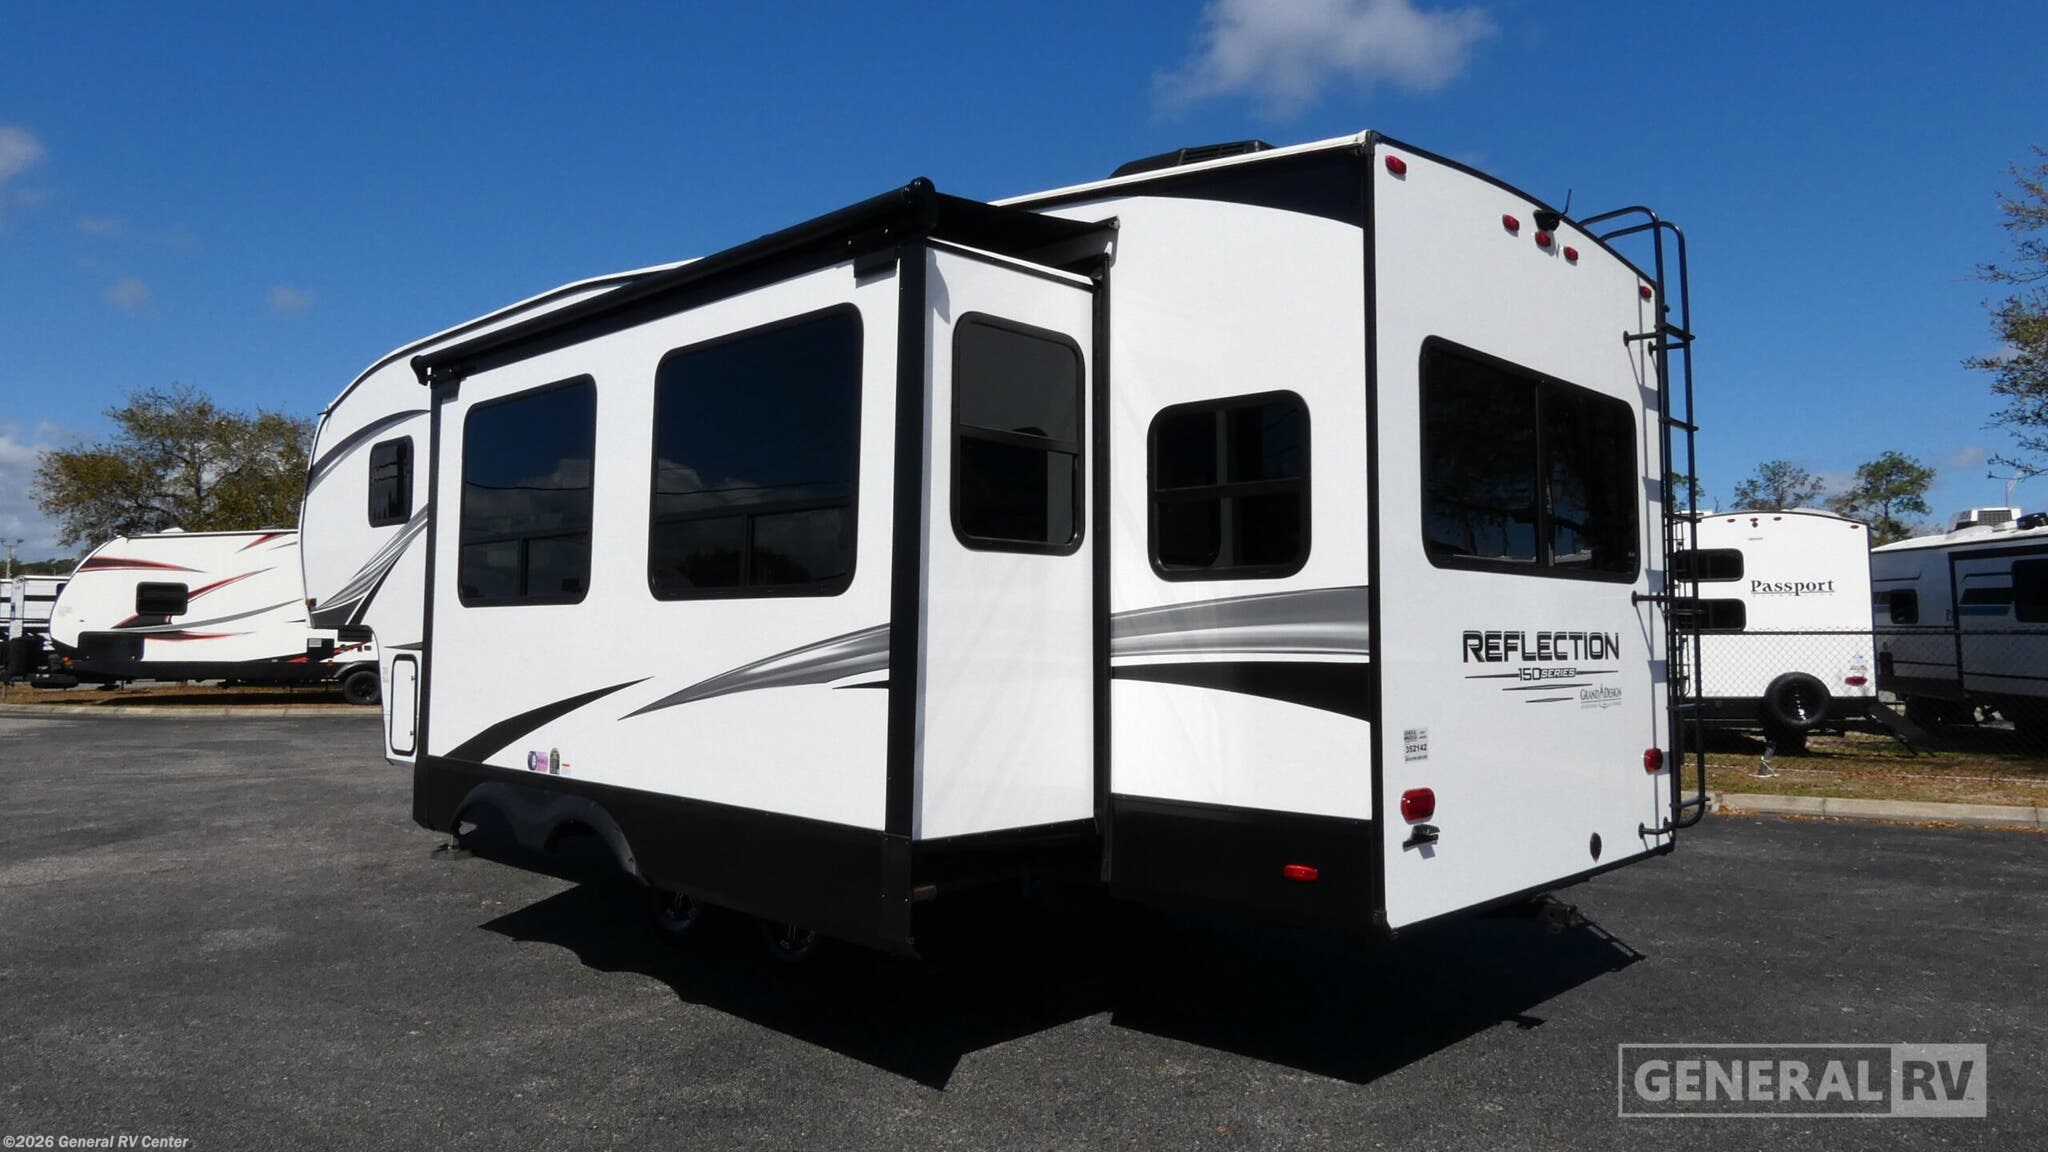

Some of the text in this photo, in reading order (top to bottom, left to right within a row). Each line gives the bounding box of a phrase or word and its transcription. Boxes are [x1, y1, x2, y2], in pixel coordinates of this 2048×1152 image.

[1751, 579, 1835, 596] Passport
[1462, 630, 1620, 663] REFLECTION
[1518, 667, 1576, 681] 150 SERIES
